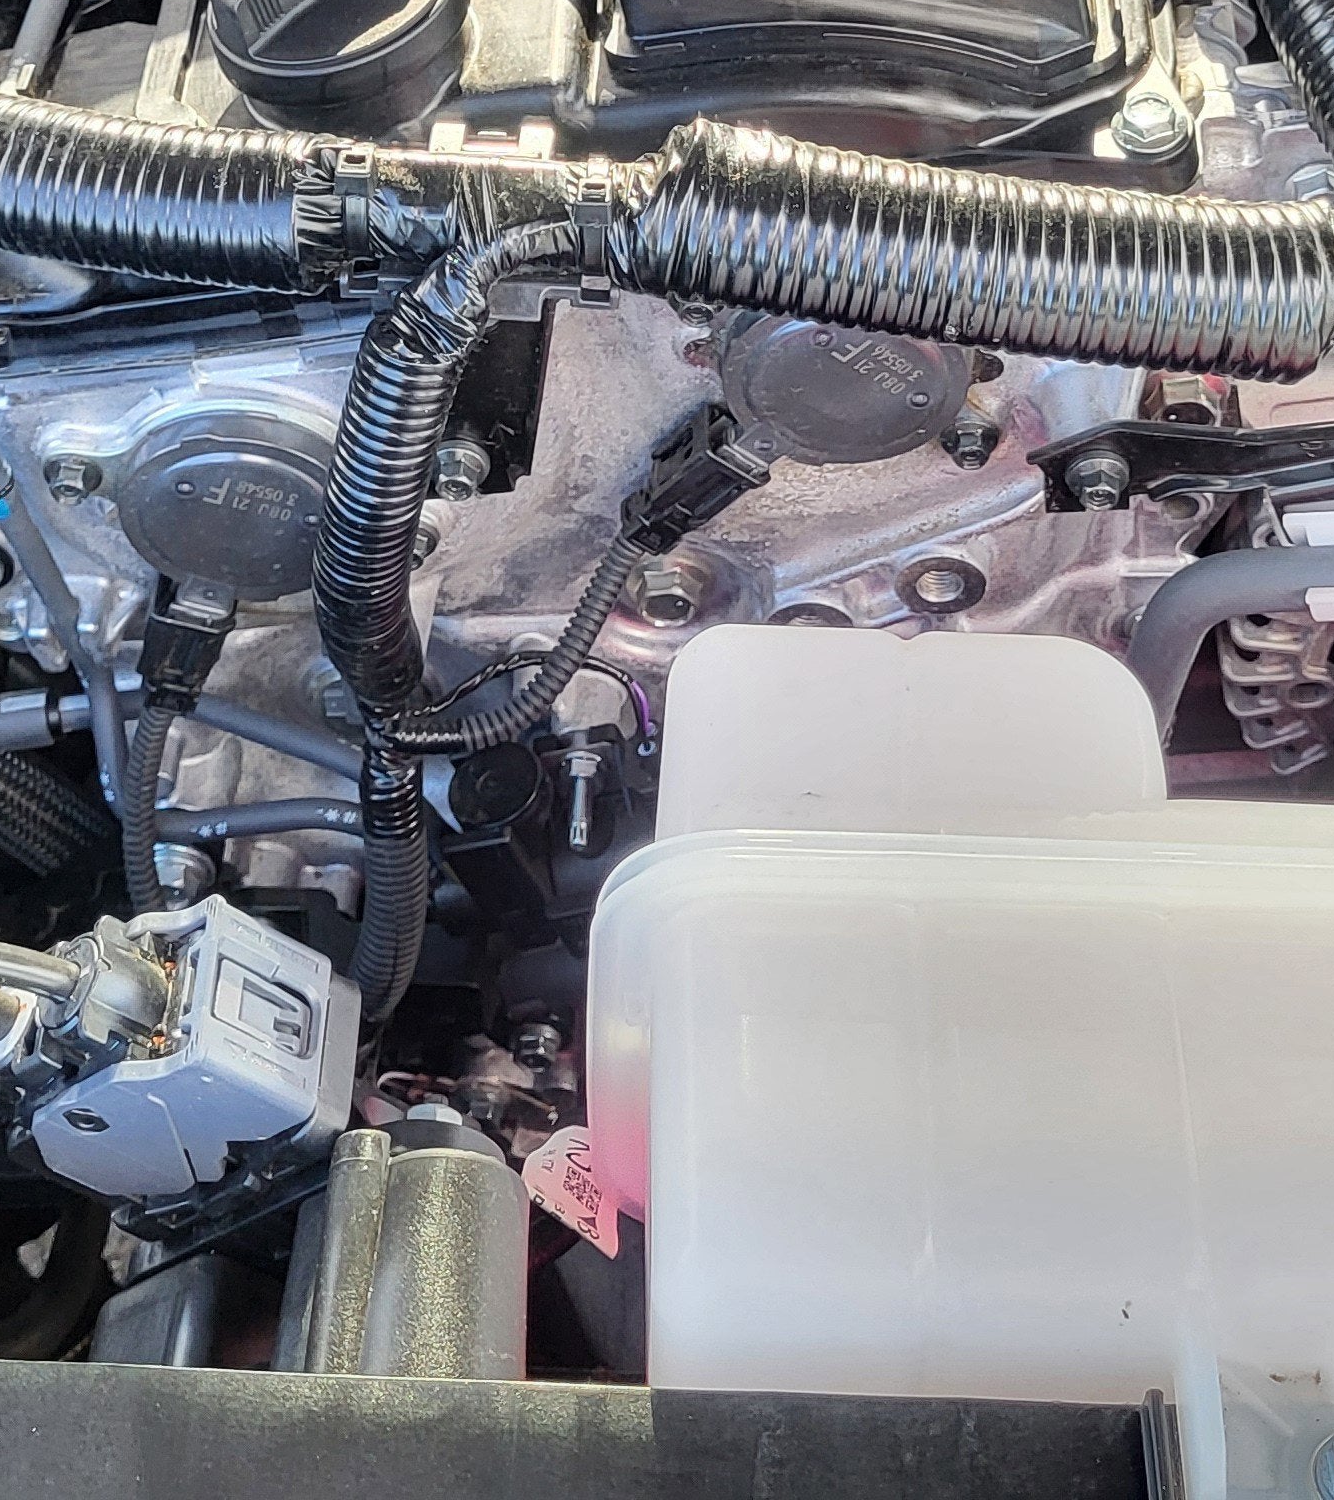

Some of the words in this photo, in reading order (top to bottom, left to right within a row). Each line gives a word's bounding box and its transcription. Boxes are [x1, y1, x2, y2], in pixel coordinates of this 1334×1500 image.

[830, 338, 873, 363] F
[906, 368, 924, 382] 3
[202, 477, 231, 505] F
